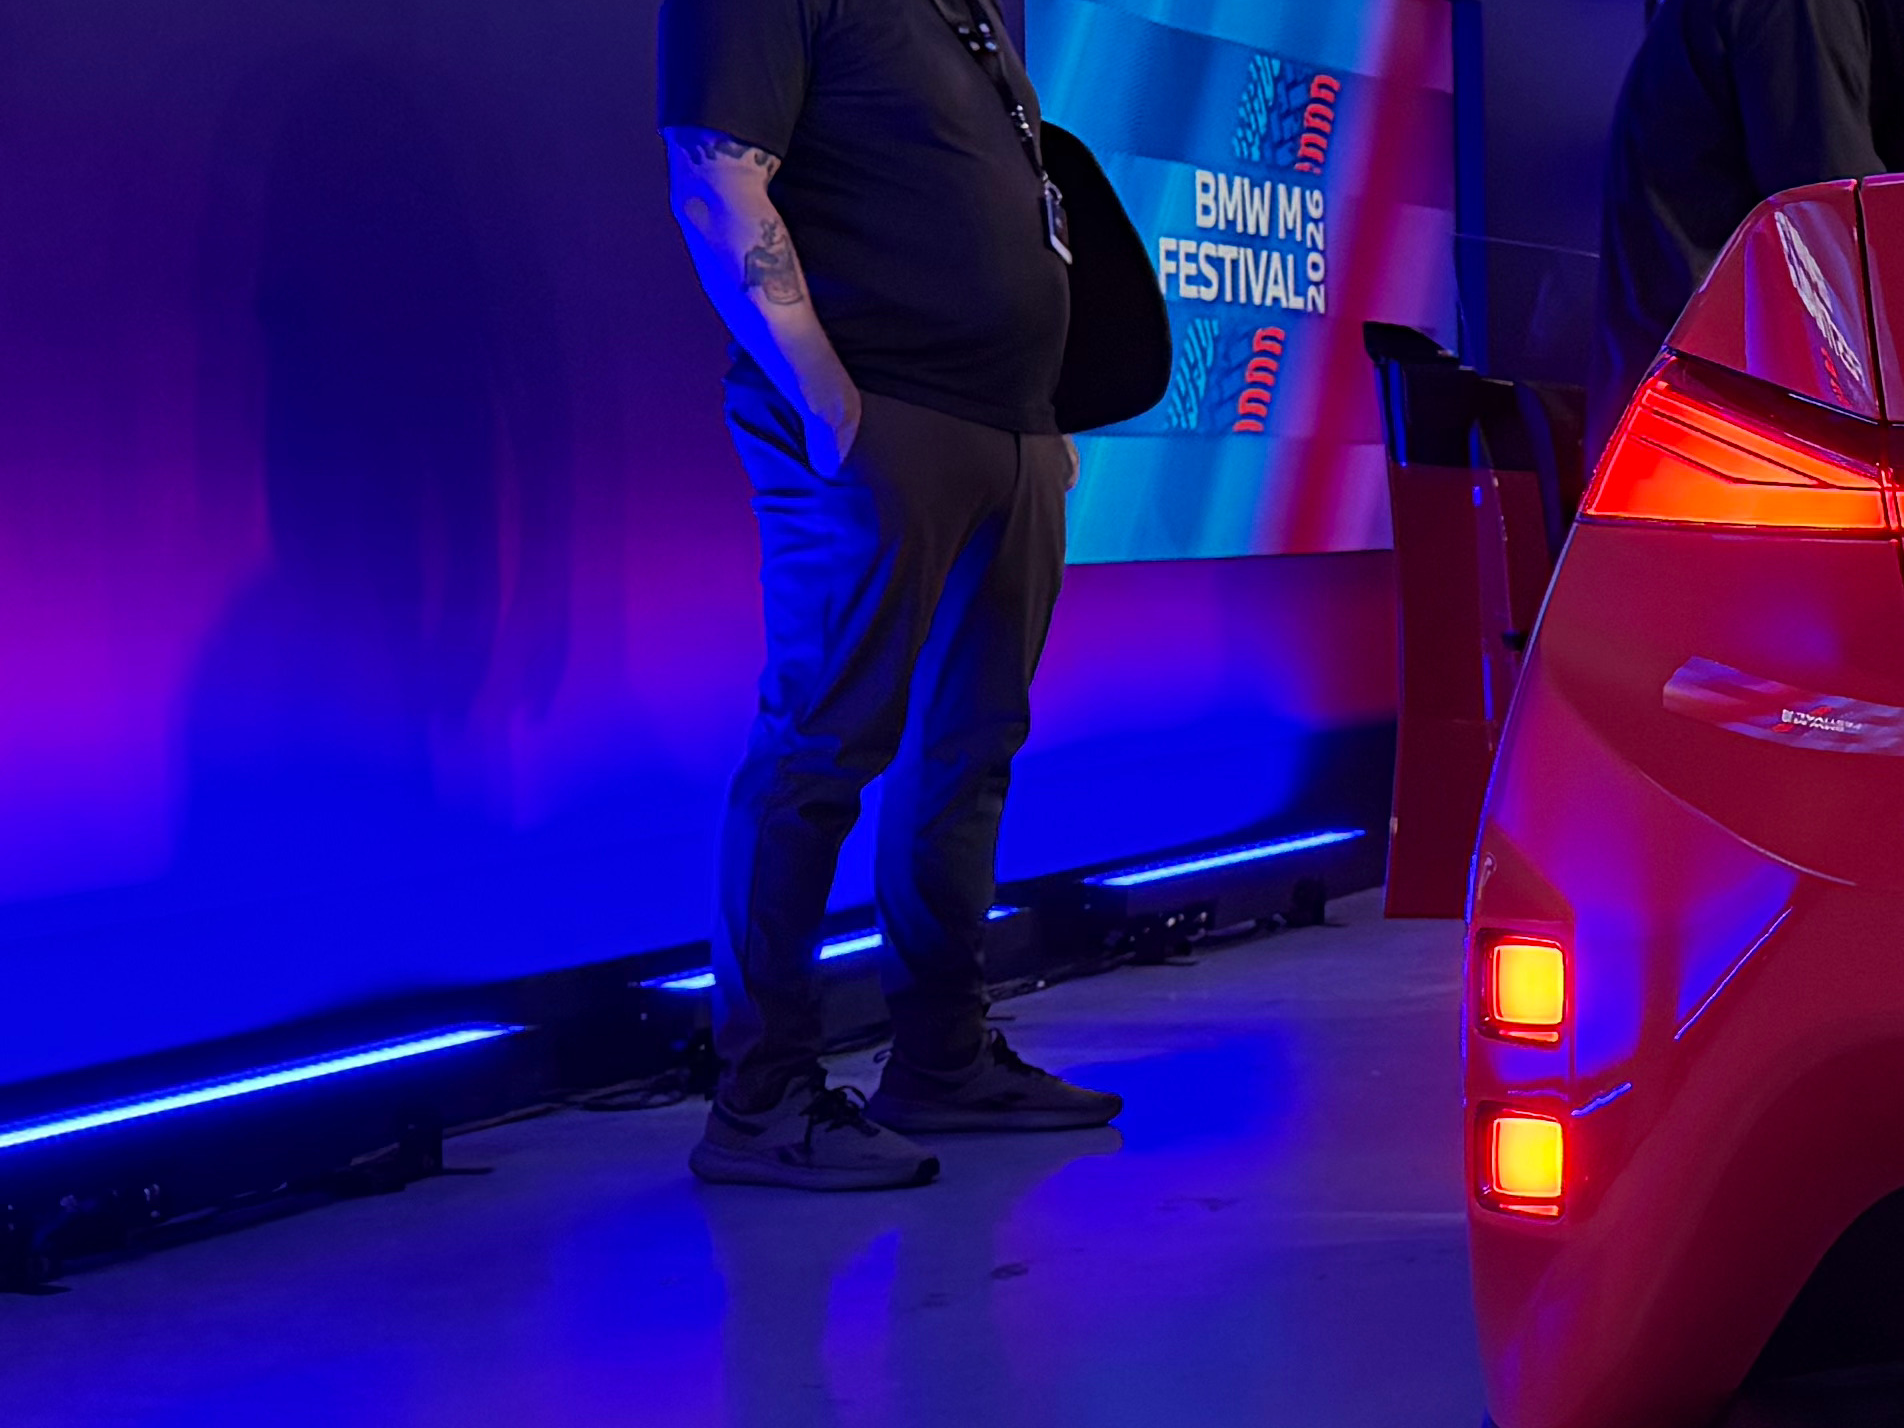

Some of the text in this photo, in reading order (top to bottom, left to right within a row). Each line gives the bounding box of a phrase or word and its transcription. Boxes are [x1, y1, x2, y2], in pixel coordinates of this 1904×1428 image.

[1195, 169, 1302, 242] BMW M
[1158, 236, 1305, 310] FESTIVAL
[1304, 189, 1326, 314] 2026
